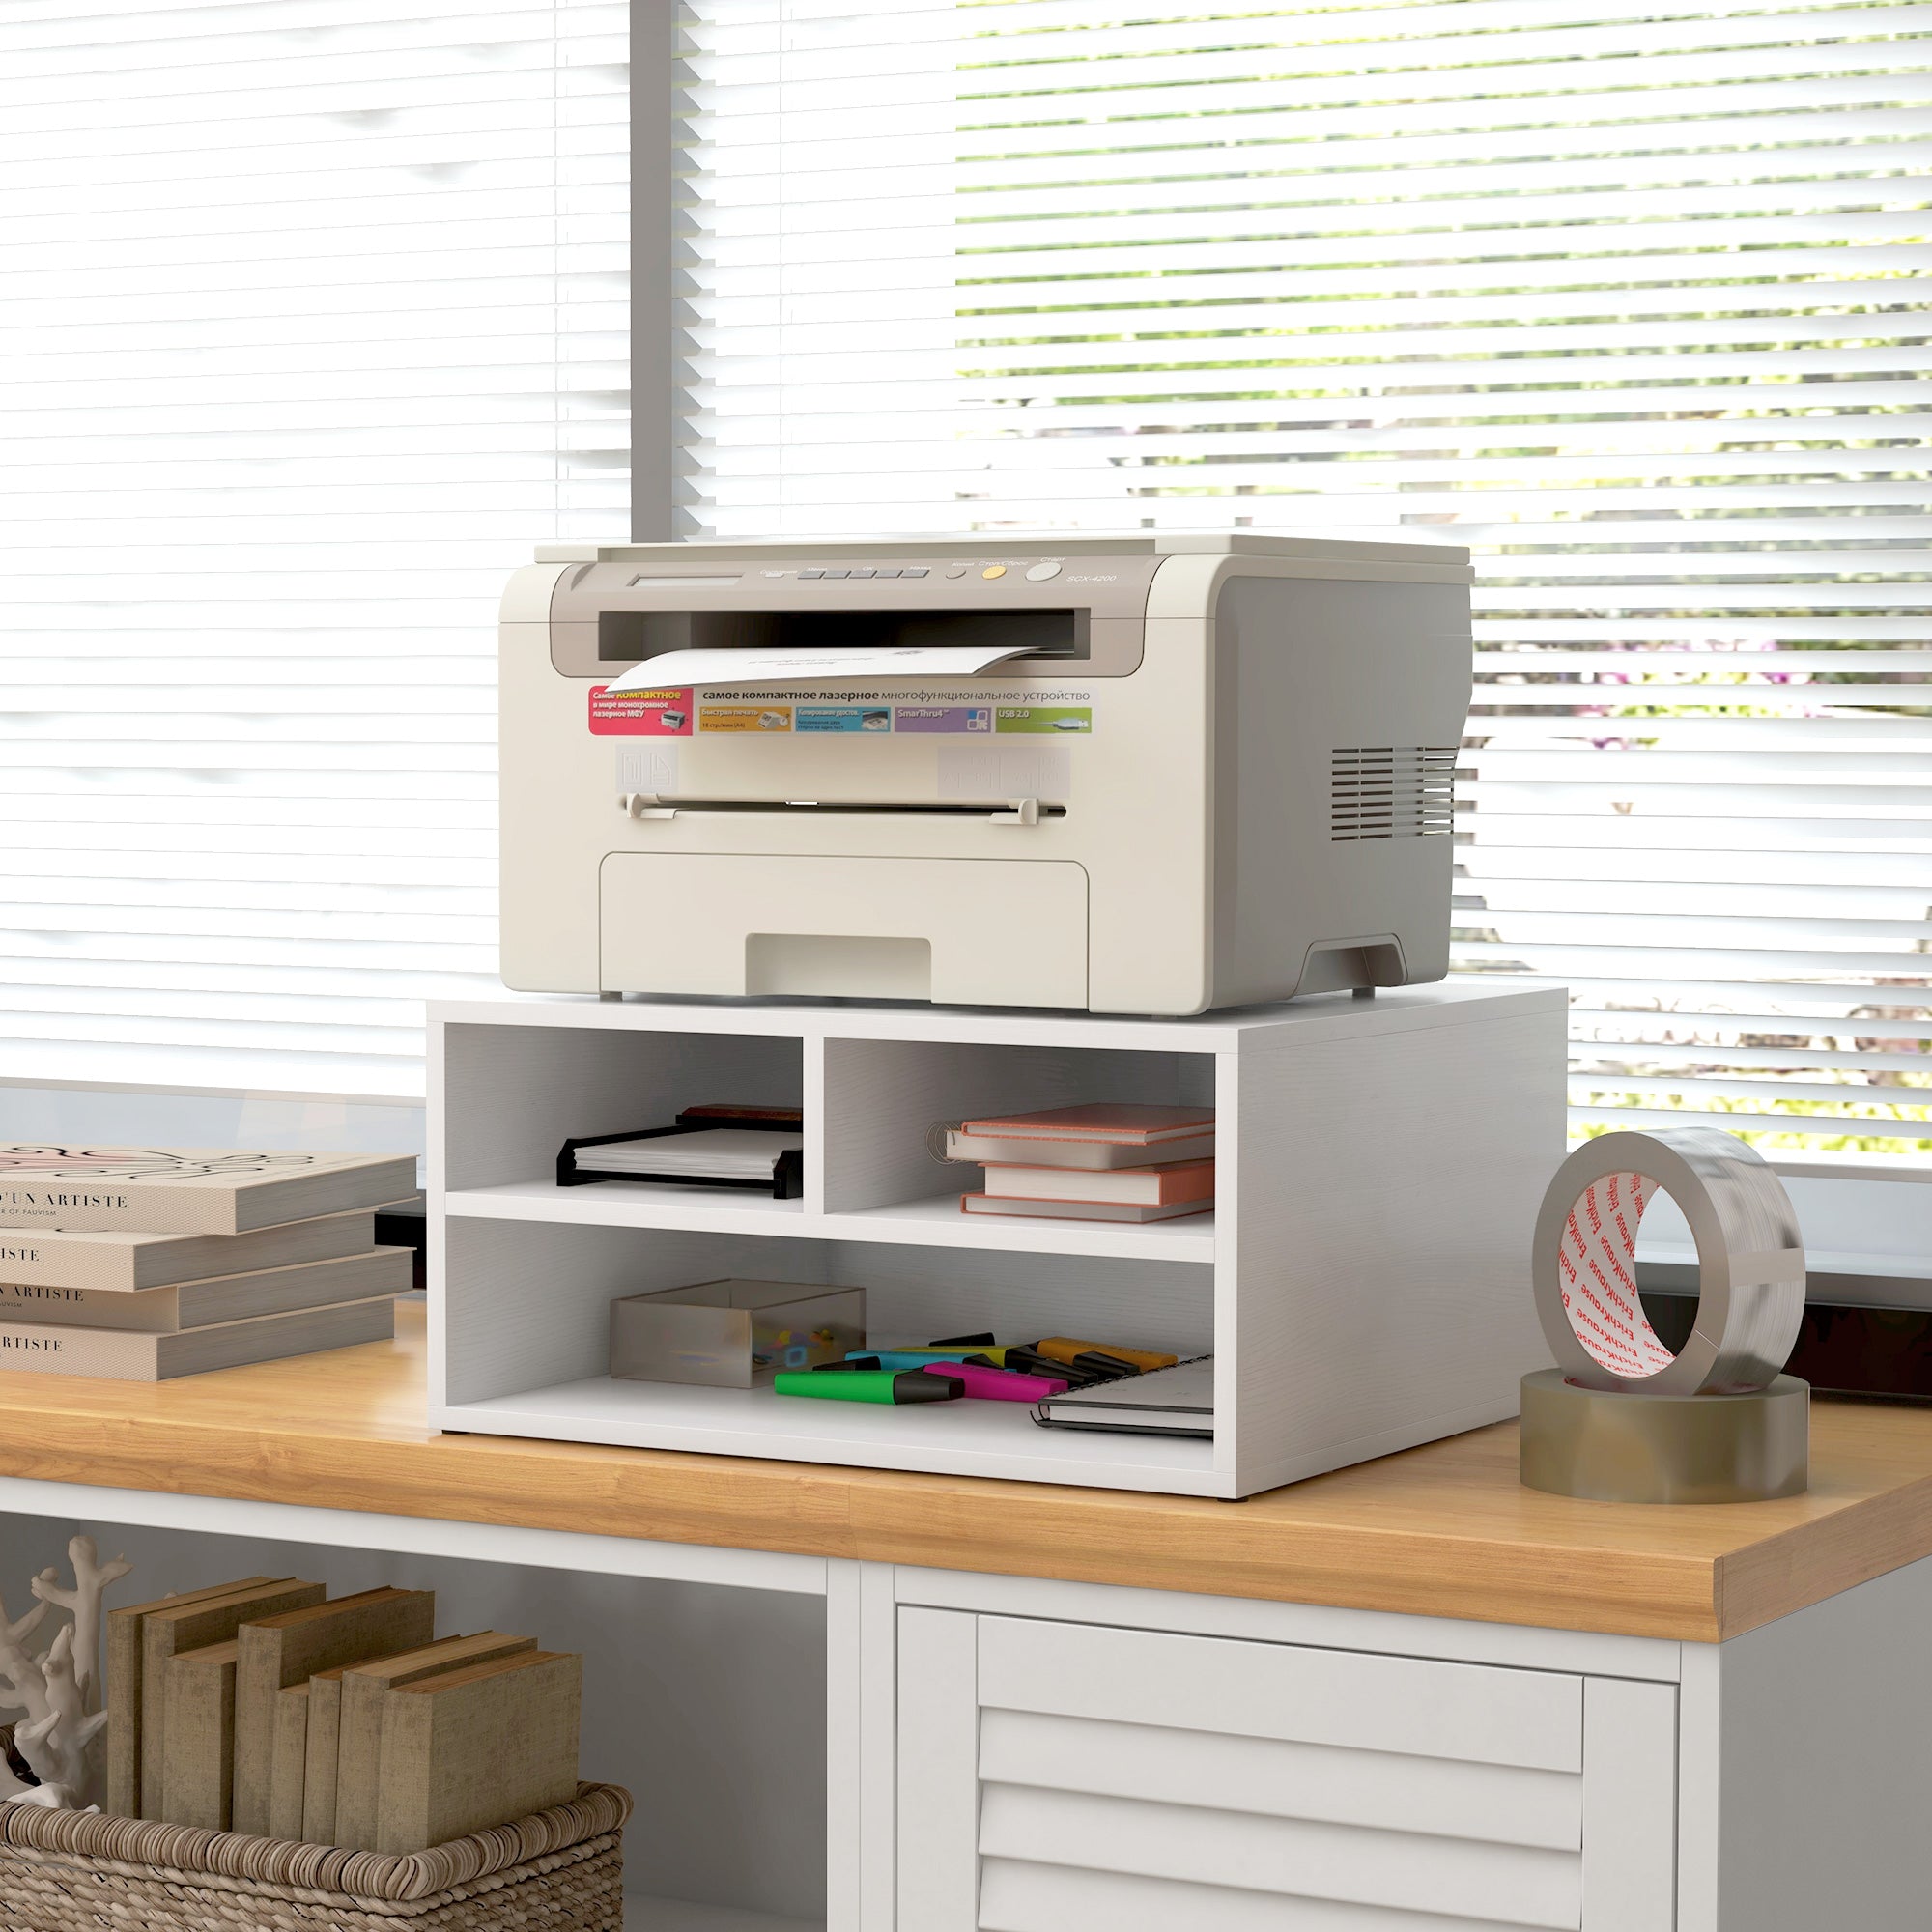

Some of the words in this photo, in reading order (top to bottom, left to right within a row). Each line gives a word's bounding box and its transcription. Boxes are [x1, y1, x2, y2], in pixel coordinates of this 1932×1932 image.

[702, 691, 740, 700] самое
[742, 691, 817, 700] компактное
[819, 691, 879, 702] лазерное
[881, 690, 1020, 702] многофункциональное
[1022, 690, 1091, 702] устройство
[998, 709, 1015, 718] USB
[1016, 709, 1030, 718] 2.0
[0, 1192, 35, 1204] 'UN
[45, 1194, 128, 1208] ARTISTE
[1600, 1235, 1636, 1298] ErichKrause
[13, 1286, 84, 1301] ARTISTE
[1588, 1259, 1634, 1321] ErichKrause
[1580, 1283, 1634, 1341] ErichKrause
[1576, 1330, 1644, 1369] ErichKrause
[1577, 1308, 1638, 1357] ErichKrause
